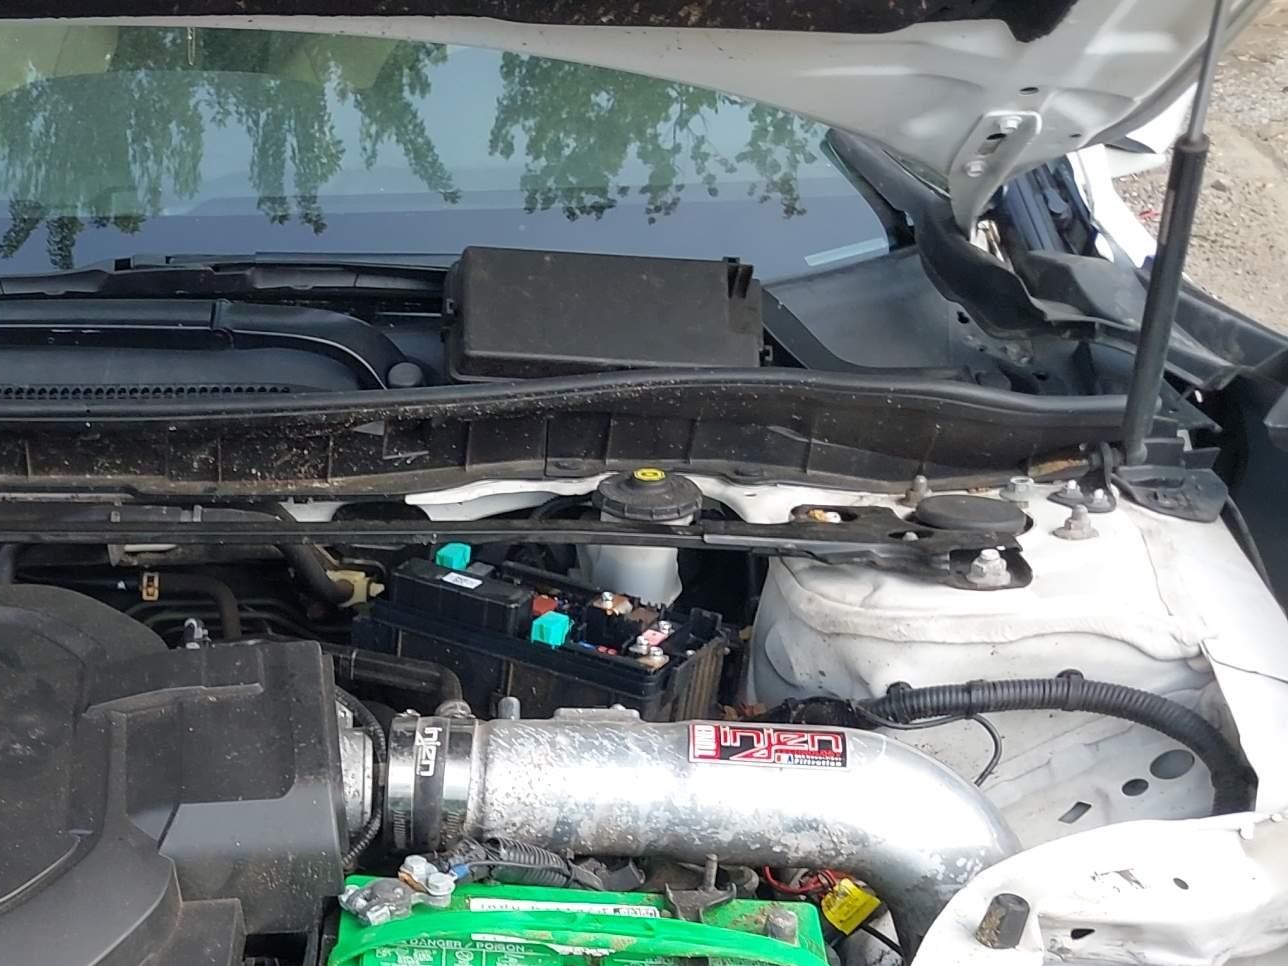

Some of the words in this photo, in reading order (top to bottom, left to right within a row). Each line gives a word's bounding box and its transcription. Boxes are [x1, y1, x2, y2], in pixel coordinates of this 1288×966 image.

[720, 726, 843, 761] injen
[409, 939, 461, 949] DANGER
[475, 942, 525, 953] POISON
